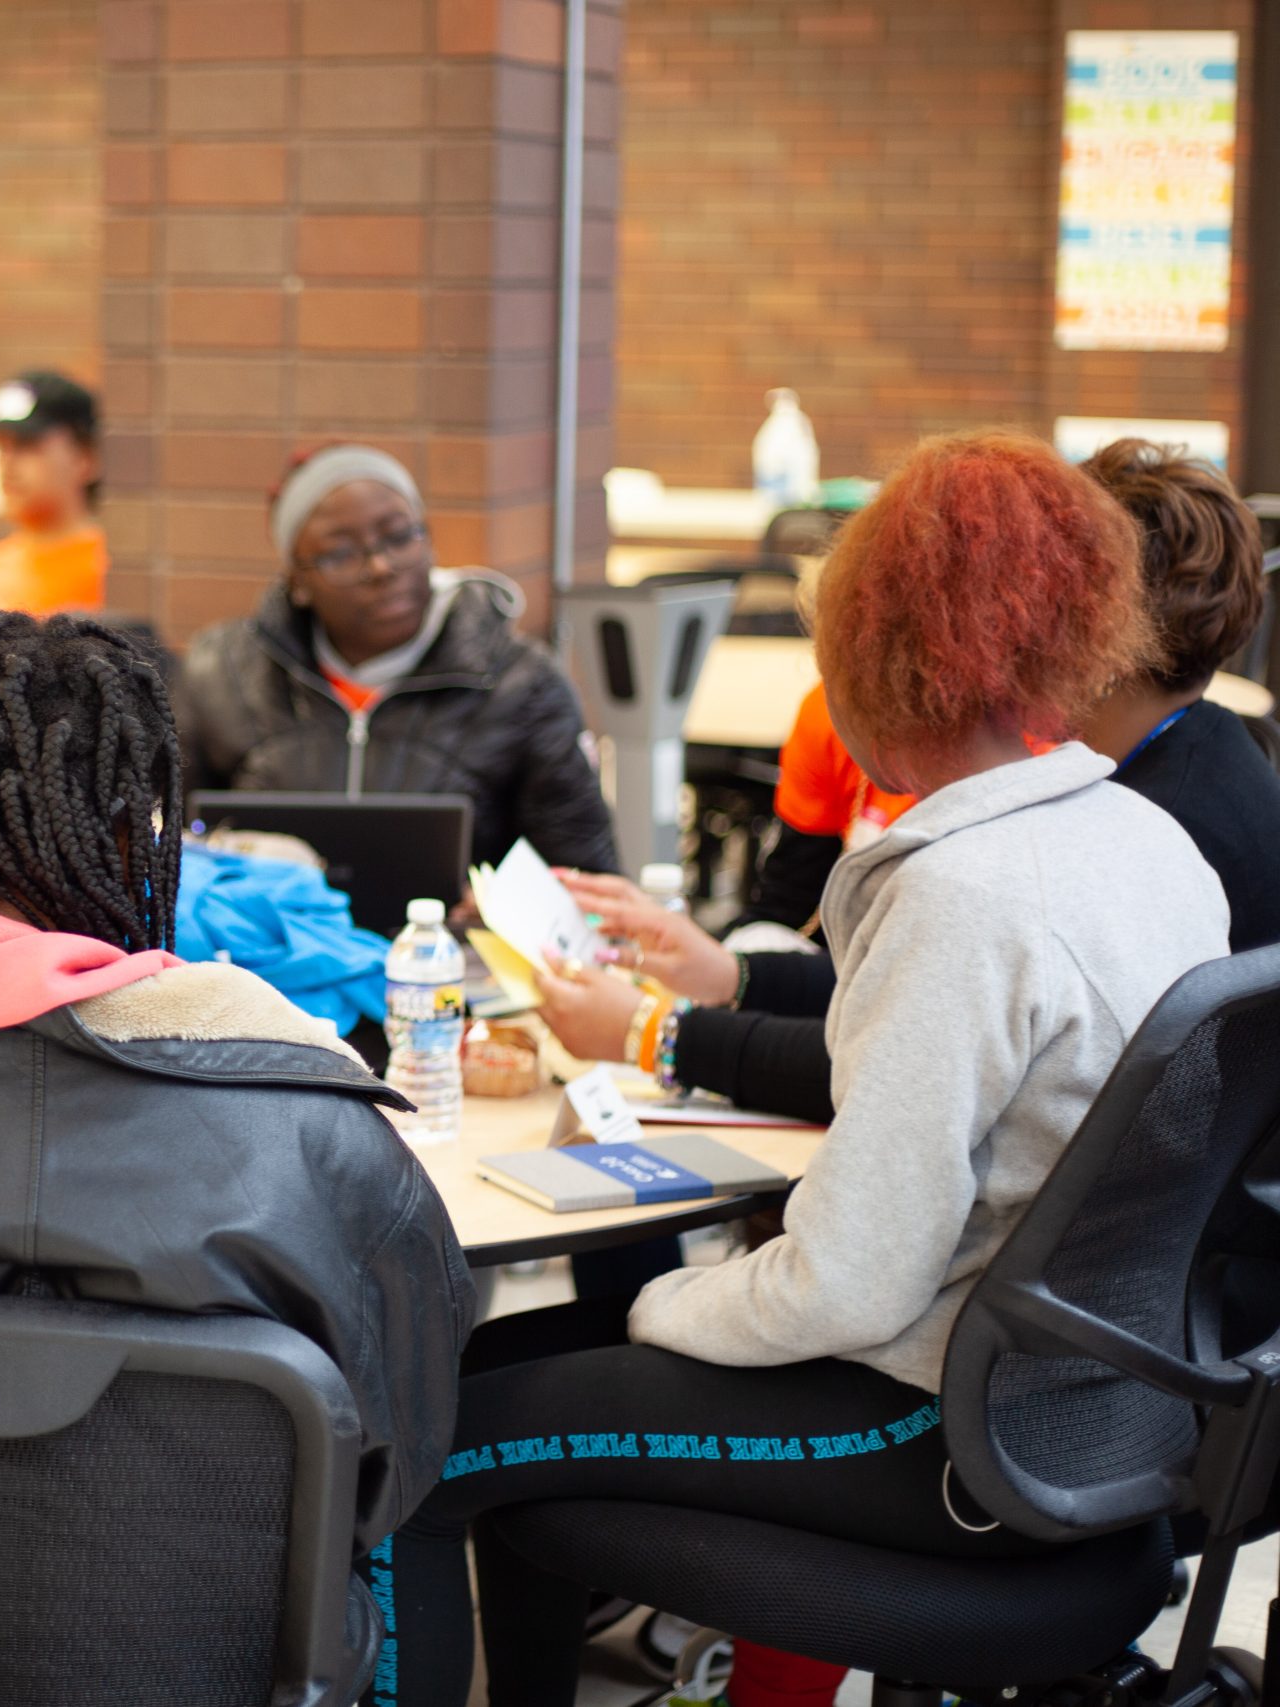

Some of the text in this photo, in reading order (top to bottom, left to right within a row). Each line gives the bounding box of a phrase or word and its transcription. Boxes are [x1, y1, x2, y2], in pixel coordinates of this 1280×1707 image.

[497, 1436, 564, 1465] PINK
[567, 1433, 640, 1458] PINK
[643, 1434, 721, 1459] PINK
[725, 1436, 805, 1460] PINK
[807, 1429, 887, 1459] PINK
